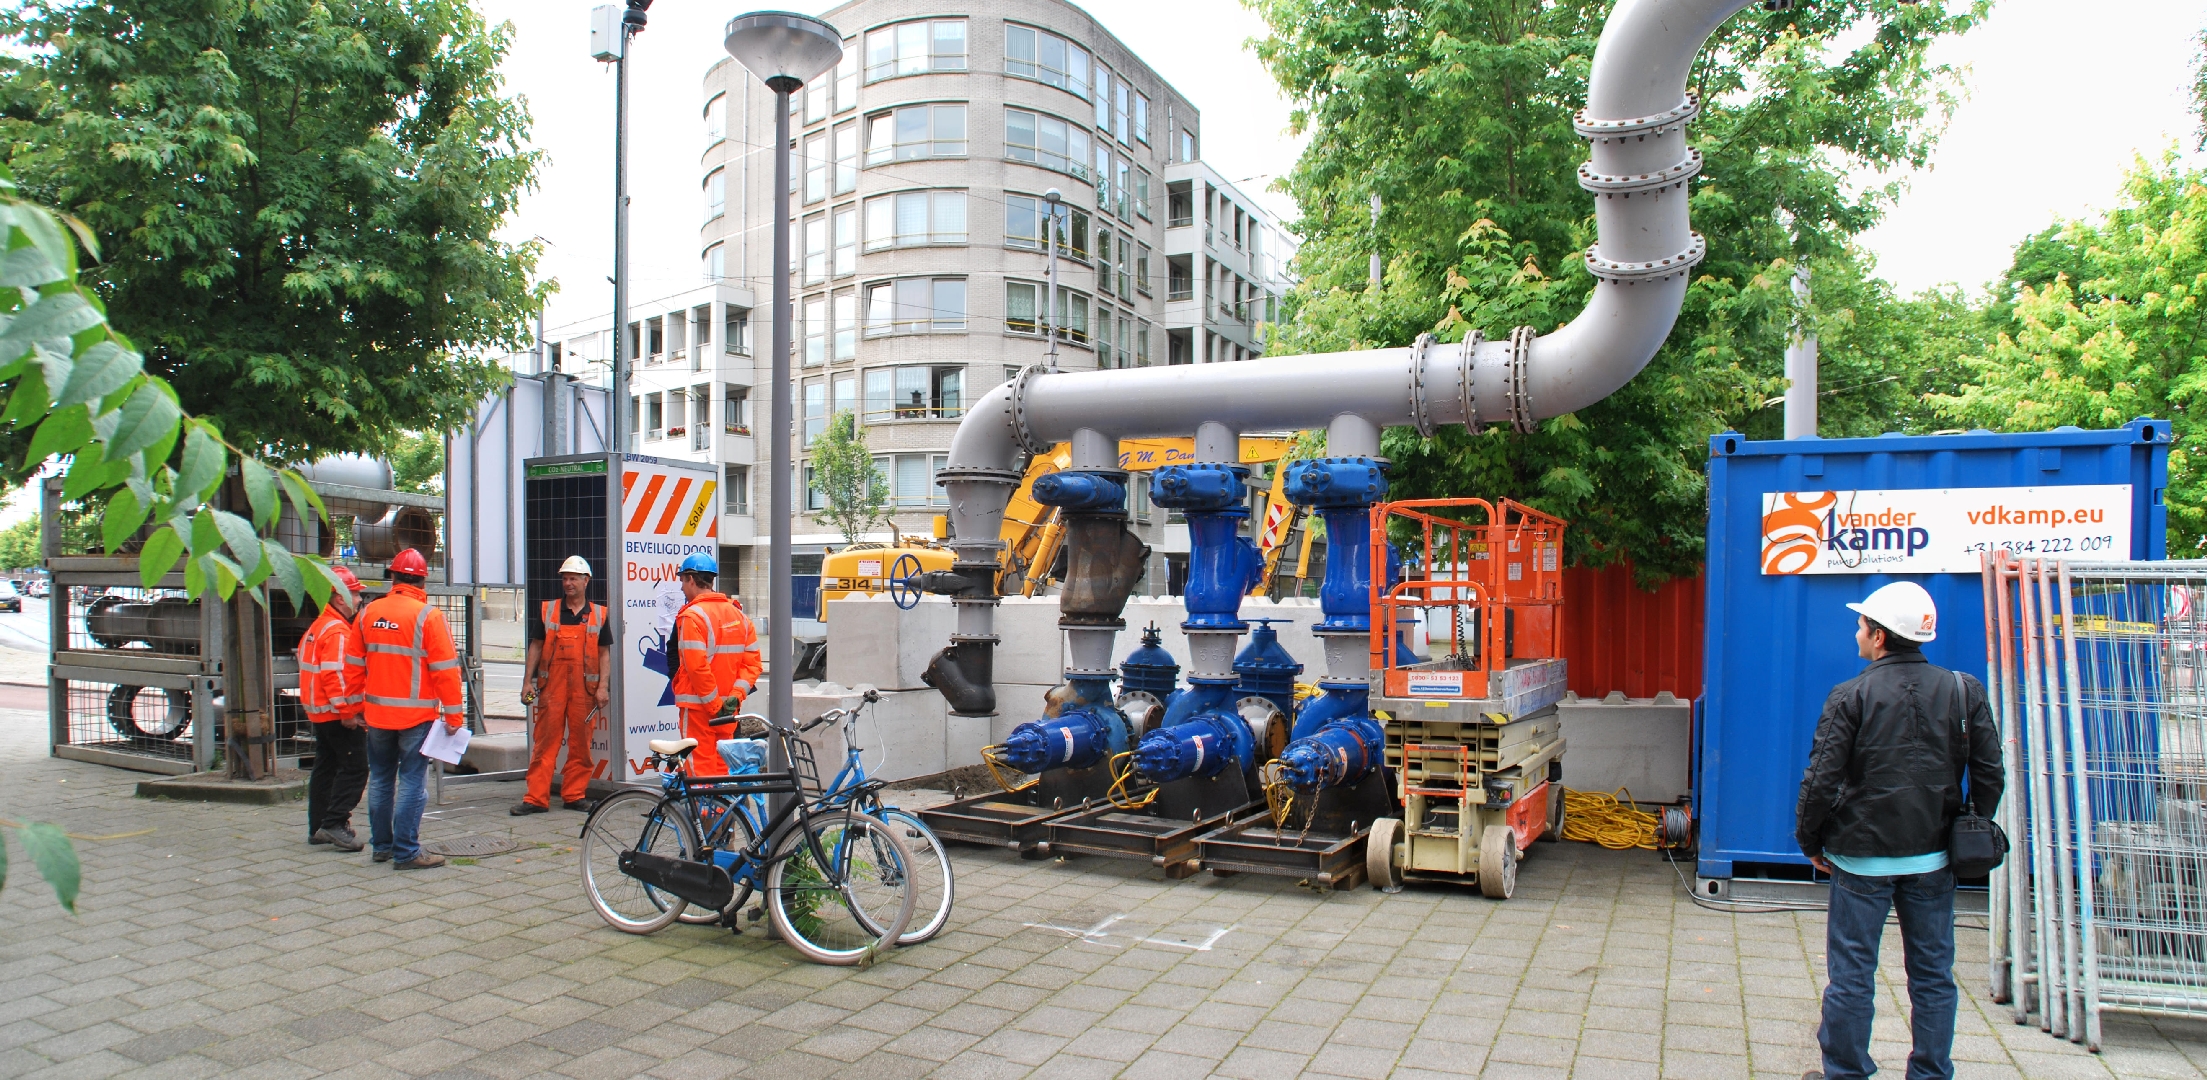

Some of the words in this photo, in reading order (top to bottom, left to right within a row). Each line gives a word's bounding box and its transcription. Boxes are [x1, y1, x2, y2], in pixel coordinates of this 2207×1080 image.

[626, 453, 640, 463] BW
[1136, 450, 1157, 463] M.
[689, 501, 706, 529] Solar
[1837, 507, 1917, 527] vander
[1966, 505, 2104, 528] vdkamp.eu
[1827, 508, 1930, 557] kamp
[626, 541, 681, 555] BEVEILIGD
[683, 544, 713, 556] DOOR
[2001, 540, 2036, 555] 384
[2040, 537, 2074, 552] 222
[2080, 535, 2113, 551] 009
[1827, 557, 1854, 568] pump
[1859, 554, 1904, 565] solutions
[627, 561, 680, 582] BouW
[838, 578, 870, 589] 314
[626, 599, 657, 608] CAMER
[373, 620, 399, 630] mjo
